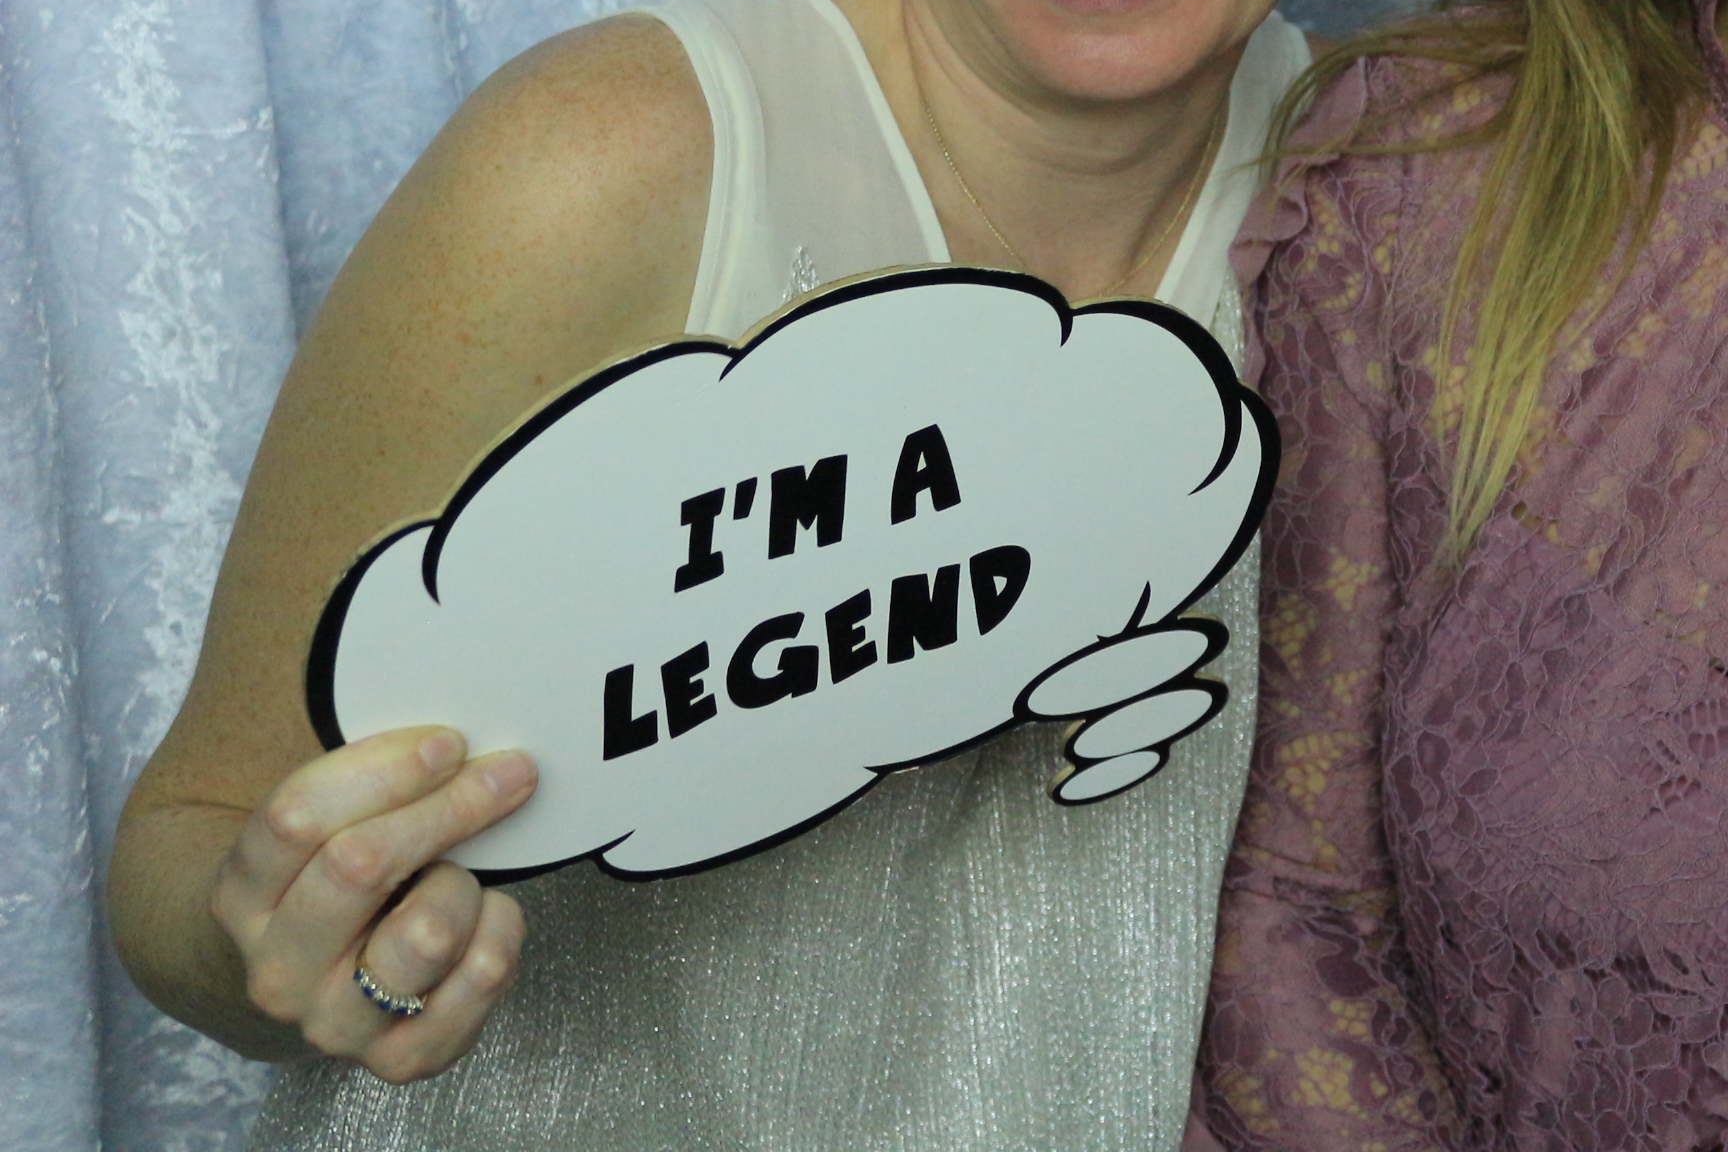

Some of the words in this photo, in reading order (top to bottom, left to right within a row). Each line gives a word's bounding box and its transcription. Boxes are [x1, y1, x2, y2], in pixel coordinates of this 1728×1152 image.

[674, 454, 848, 593] I'M
[890, 424, 961, 526] A
[602, 545, 1032, 762] LEGEND
